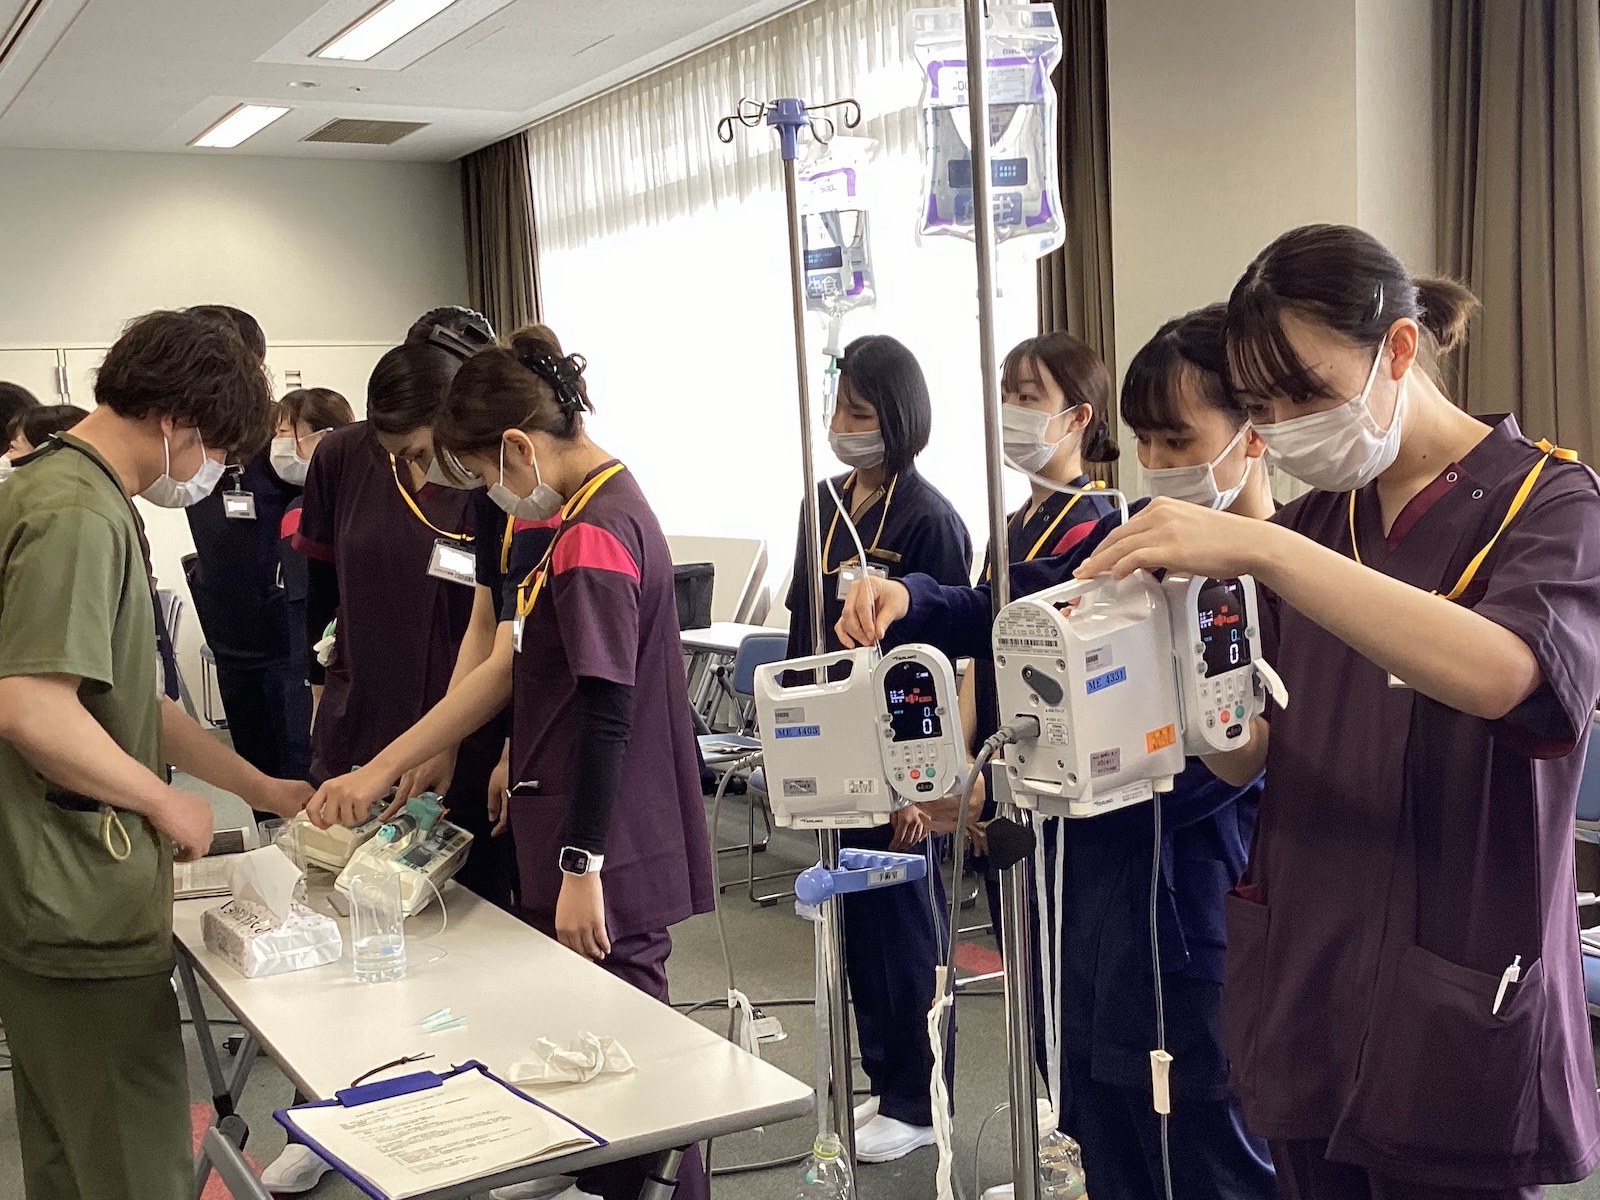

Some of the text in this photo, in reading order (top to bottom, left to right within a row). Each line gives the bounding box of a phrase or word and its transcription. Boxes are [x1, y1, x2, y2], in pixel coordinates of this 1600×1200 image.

[1229, 643, 1239, 664] 0
[1087, 670, 1124, 690] ME 4331
[922, 718, 932, 734] 0
